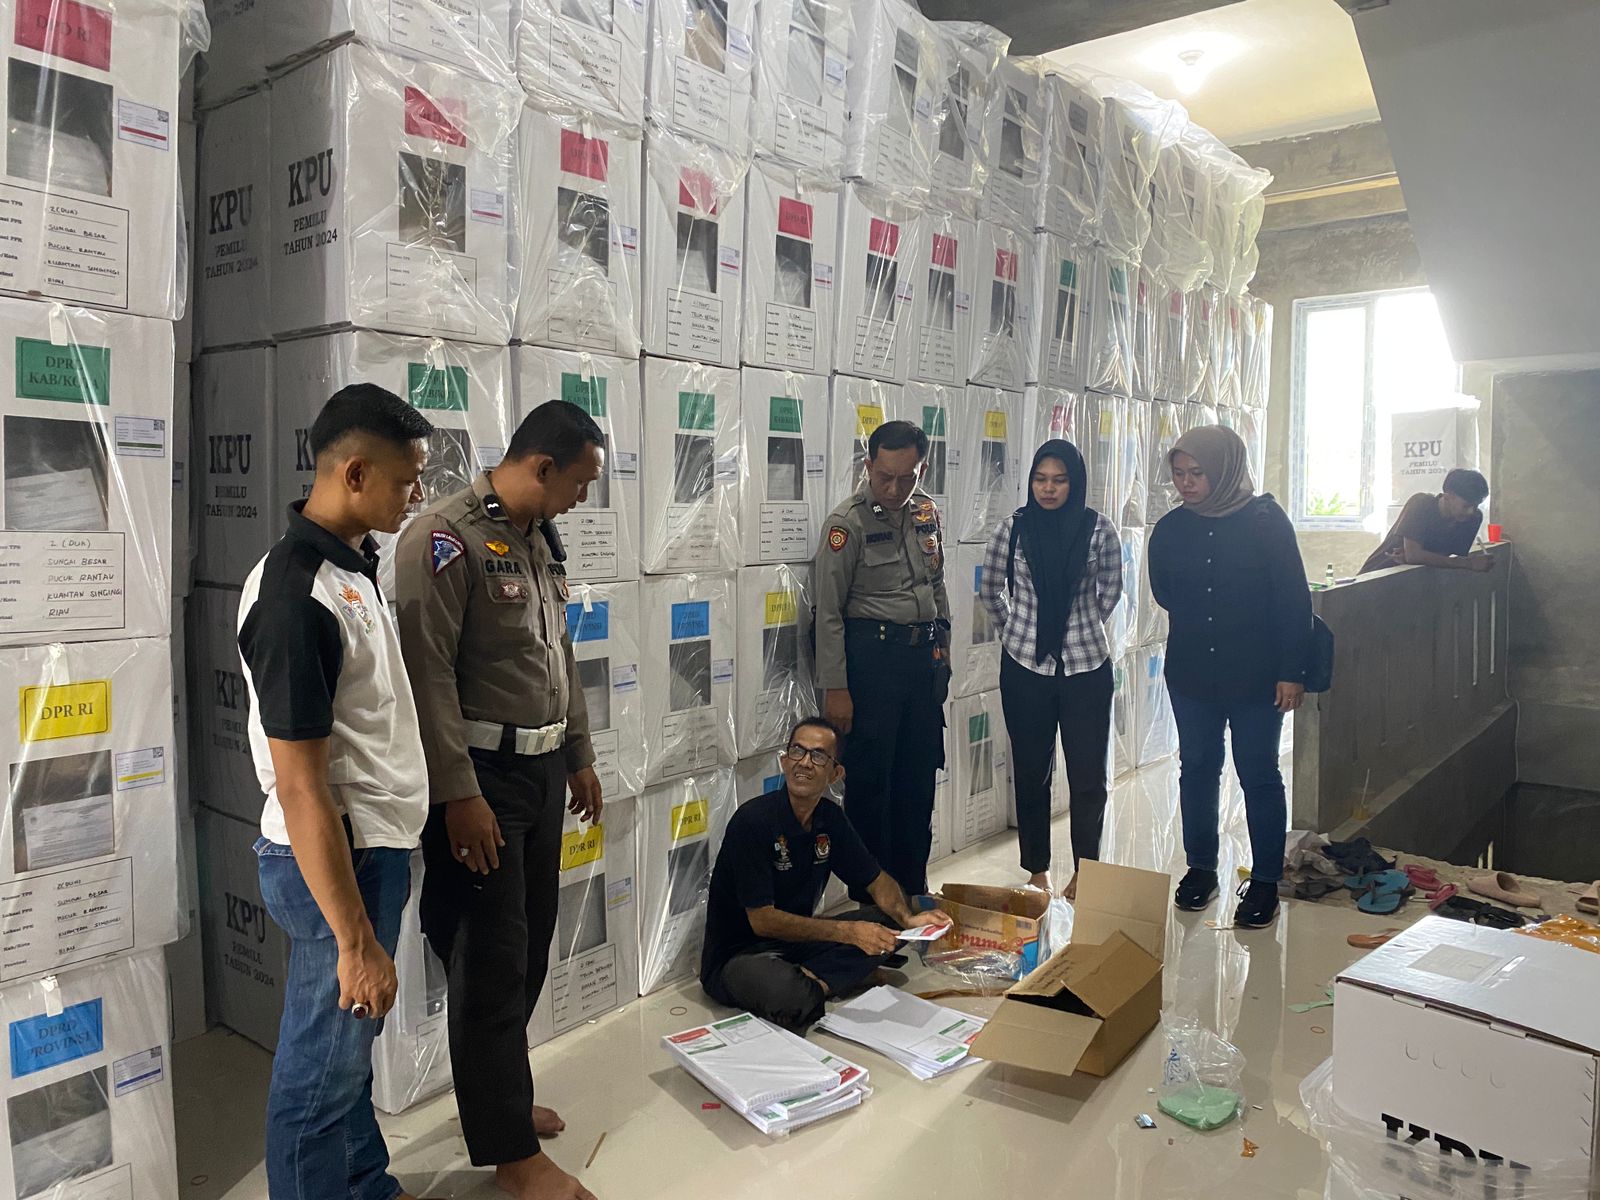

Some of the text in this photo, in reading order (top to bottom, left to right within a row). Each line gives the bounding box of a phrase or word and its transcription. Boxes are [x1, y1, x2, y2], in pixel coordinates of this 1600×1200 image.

[288, 148, 333, 208] KPU
[209, 184, 253, 235] KPU
[294, 210, 327, 232] PEMILU
[284, 228, 337, 256] TAHUN 2024
[205, 261, 234, 279] TAHUN
[209, 434, 252, 474] KPU
[1404, 440, 1442, 458] KPU
[1409, 460, 1438, 468] PEMILU
[236, 505, 258, 518] 2024
[48, 558, 76, 566] SUNGAI
[484, 559, 522, 574] GARA
[80, 573, 114, 582] RANTAU
[47, 590, 85, 600] KUANTAN
[48, 608, 70, 616] RIAU
[41, 702, 94, 720] DPR RI
[225, 892, 266, 944] KPU
